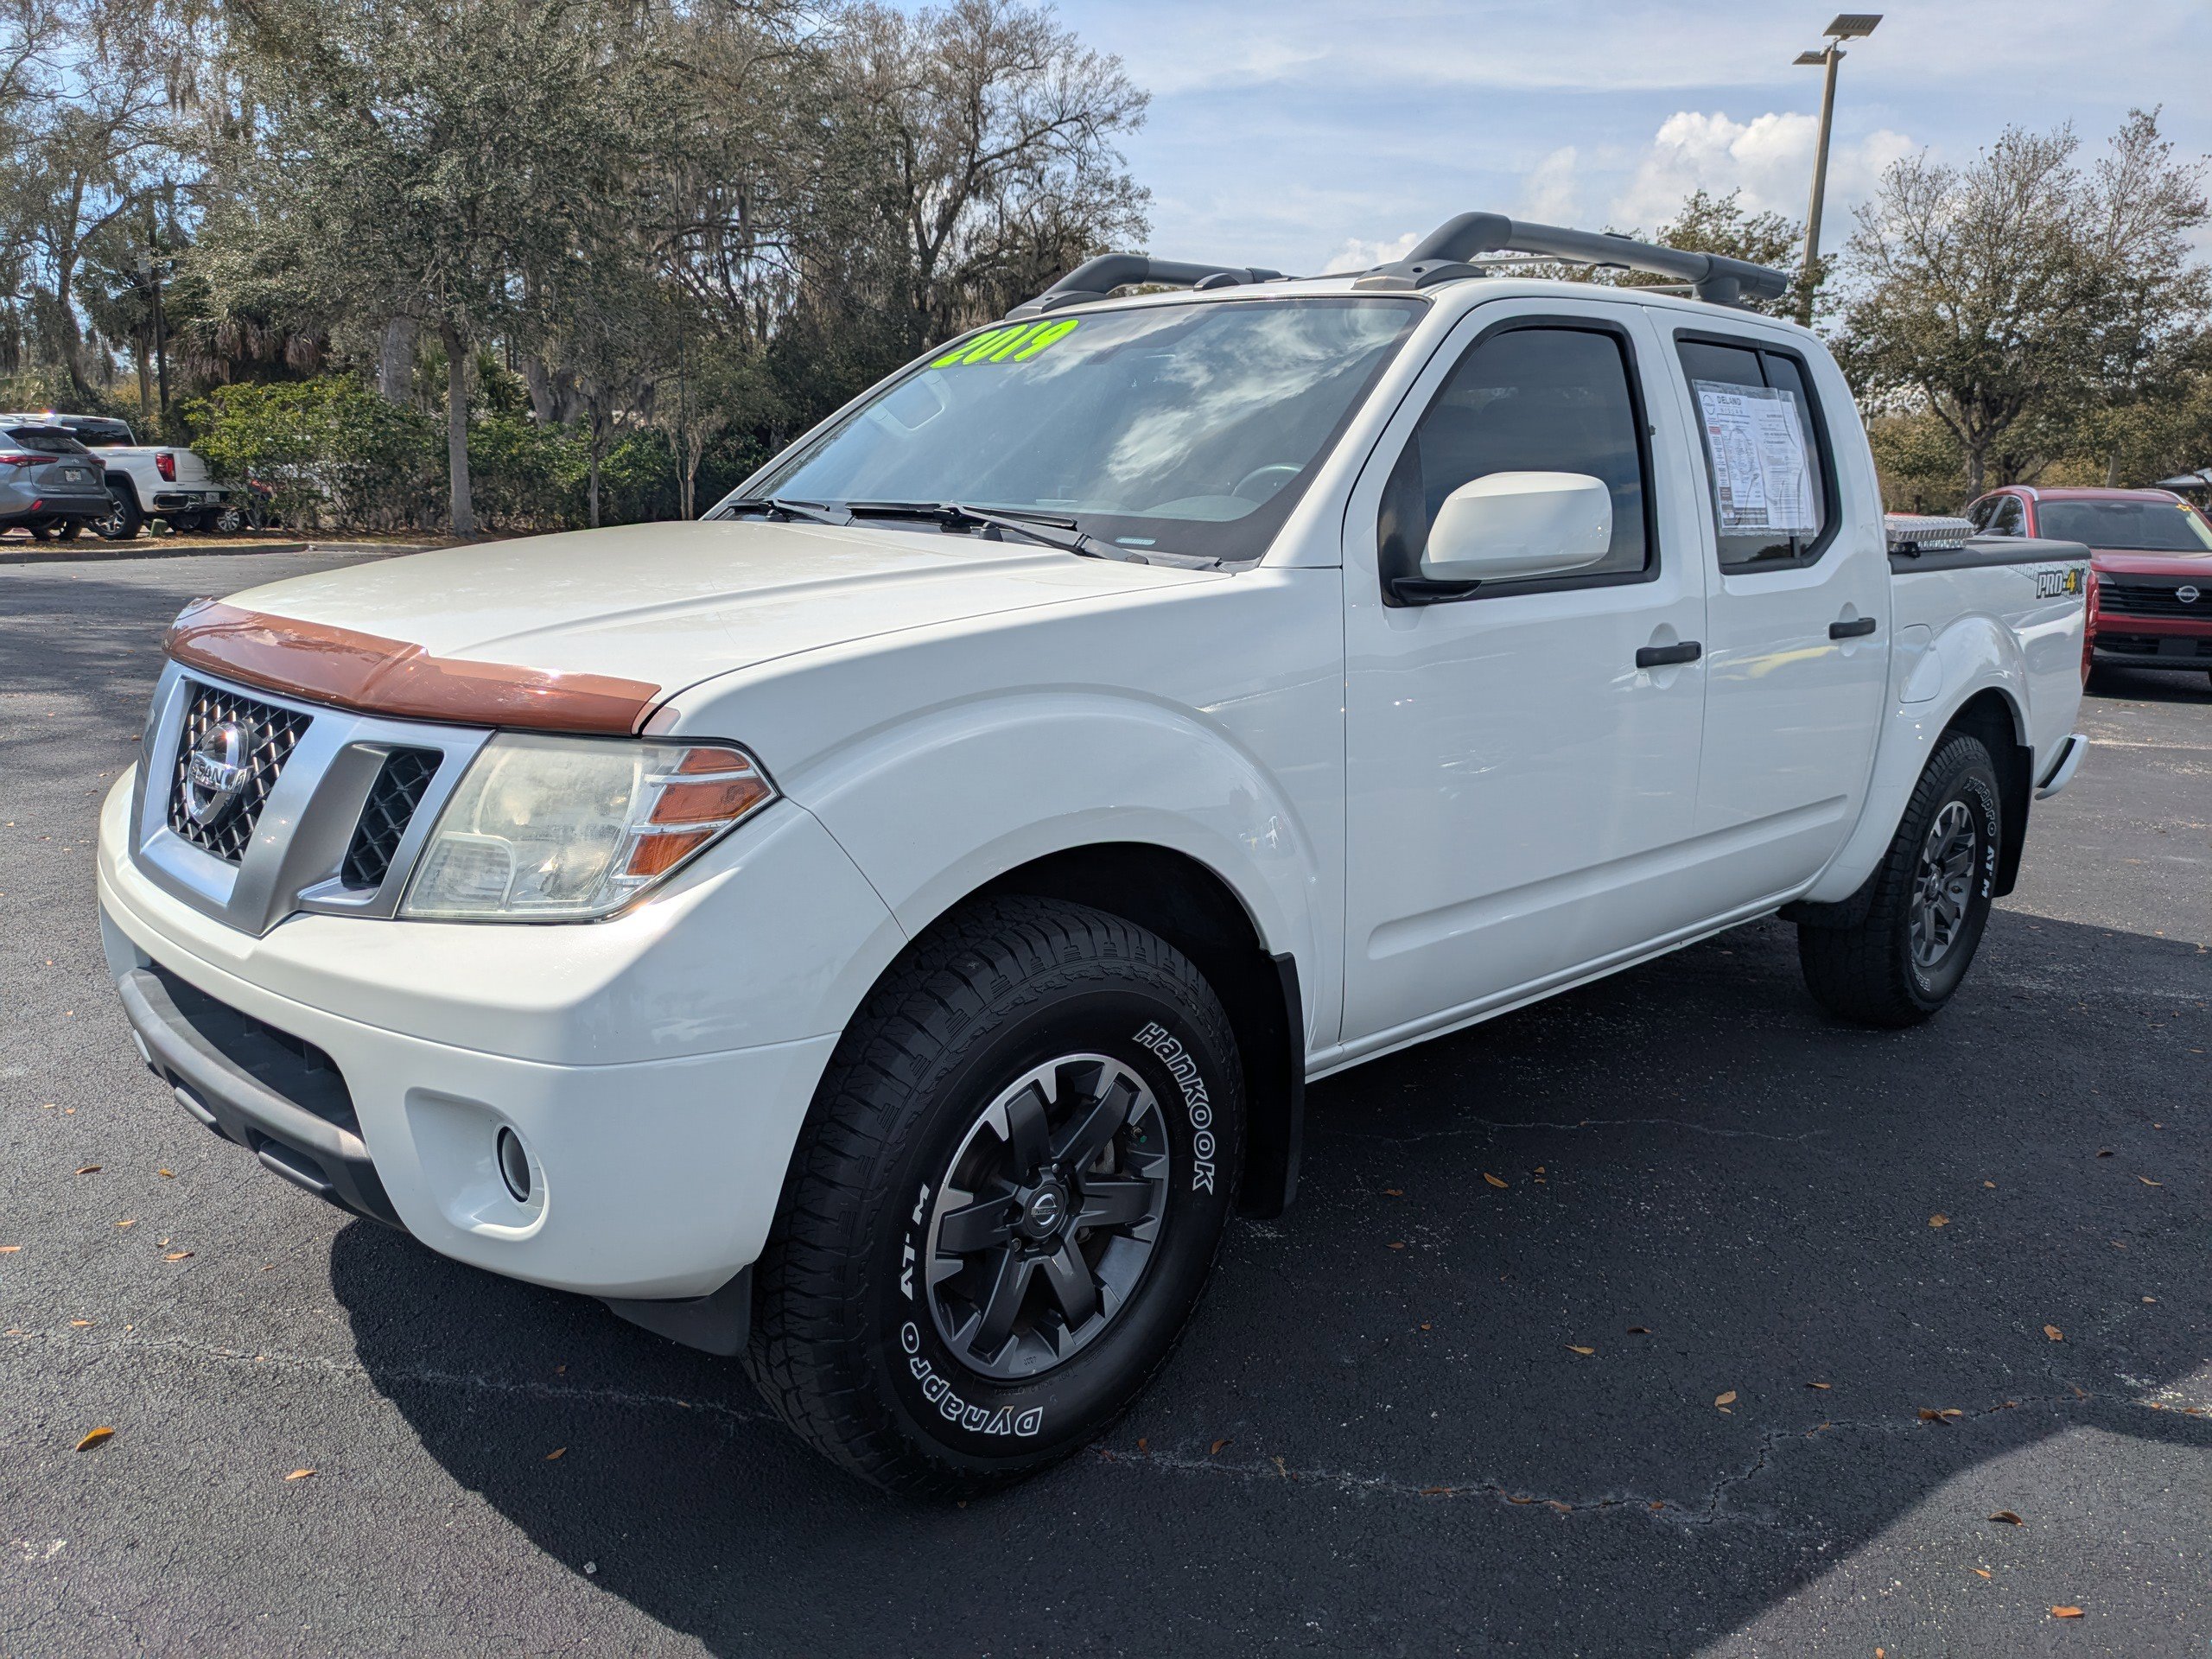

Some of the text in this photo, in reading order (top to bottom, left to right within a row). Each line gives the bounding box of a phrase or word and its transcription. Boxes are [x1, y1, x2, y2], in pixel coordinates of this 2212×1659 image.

[929, 319, 1079, 369] 2019
[1717, 396, 1742, 405] DELAND
[2036, 569, 2085, 599] PRO-4X
[1132, 1021, 1216, 1195] Hankook
[901, 1321, 1043, 1437] Dynapro
